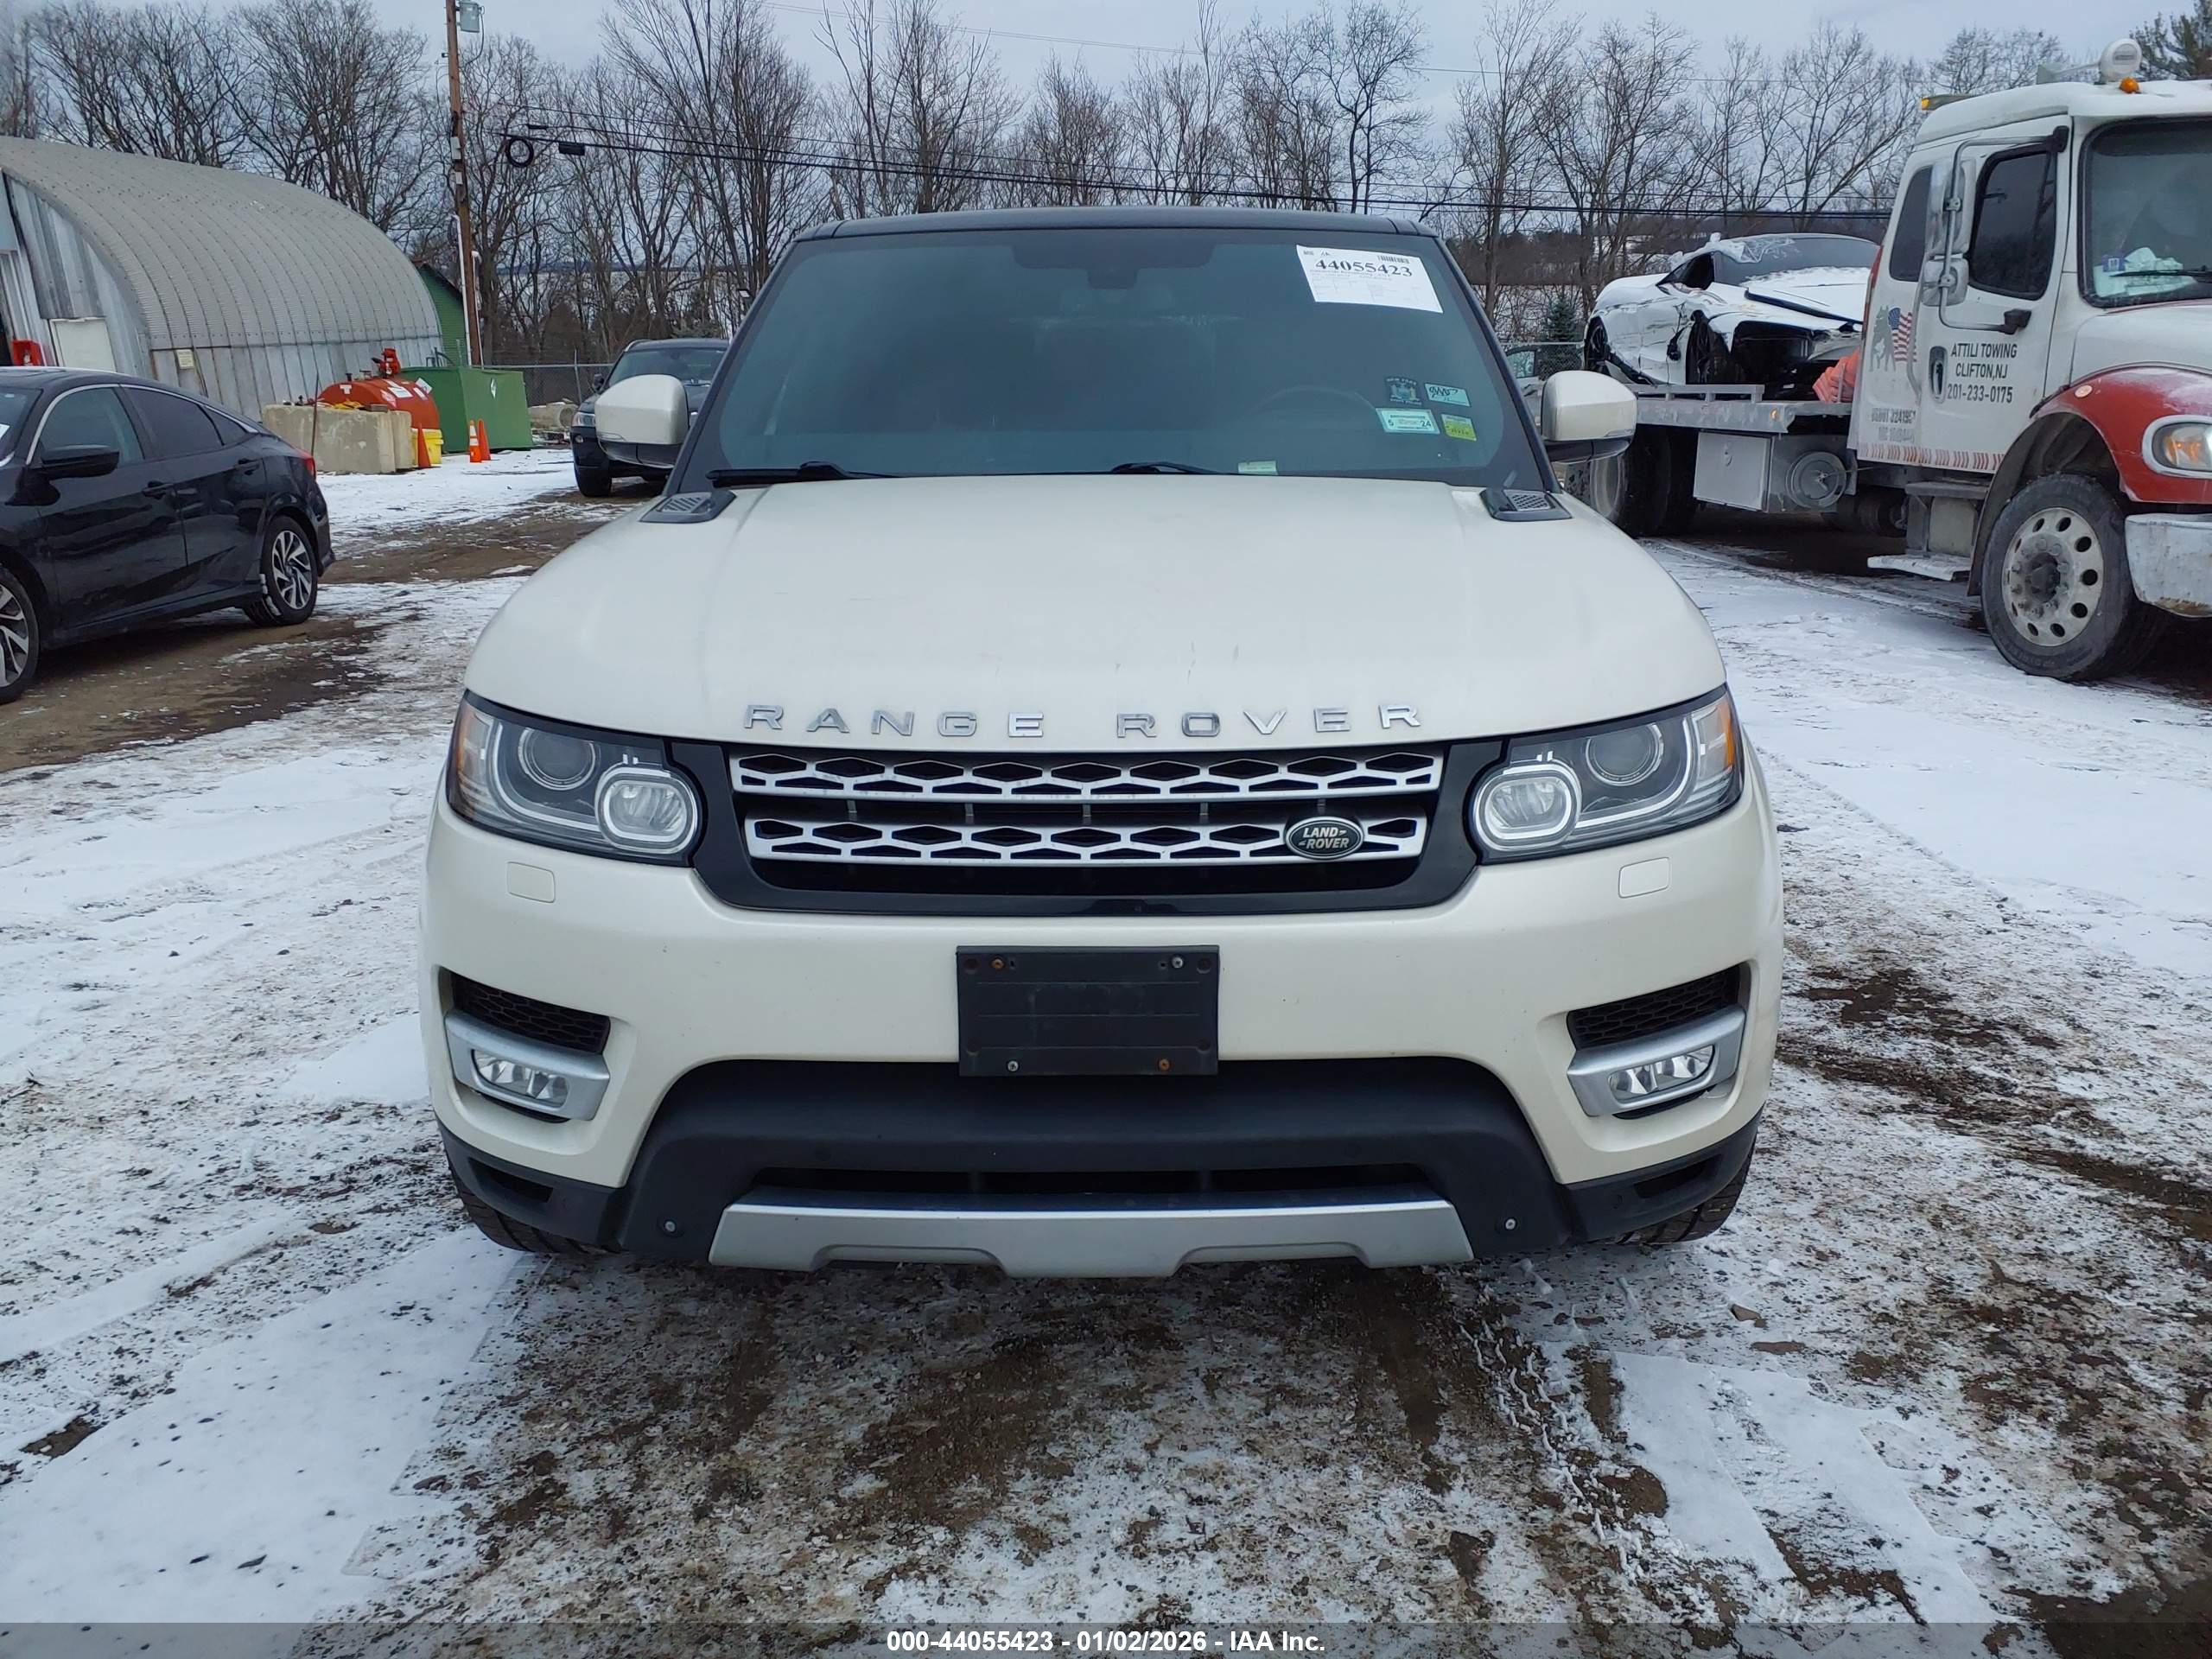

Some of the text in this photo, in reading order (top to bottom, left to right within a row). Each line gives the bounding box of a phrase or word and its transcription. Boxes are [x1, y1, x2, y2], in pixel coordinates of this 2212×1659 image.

[1315, 259, 1413, 277] 44055423
[1951, 343, 2018, 359] ATTILI TOWING
[1947, 384, 2013, 404] 201-233-0175
[744, 704, 1421, 738] RANGE ROVER
[1302, 827, 1338, 838] LAND
[1306, 838, 1350, 849] ROVER
